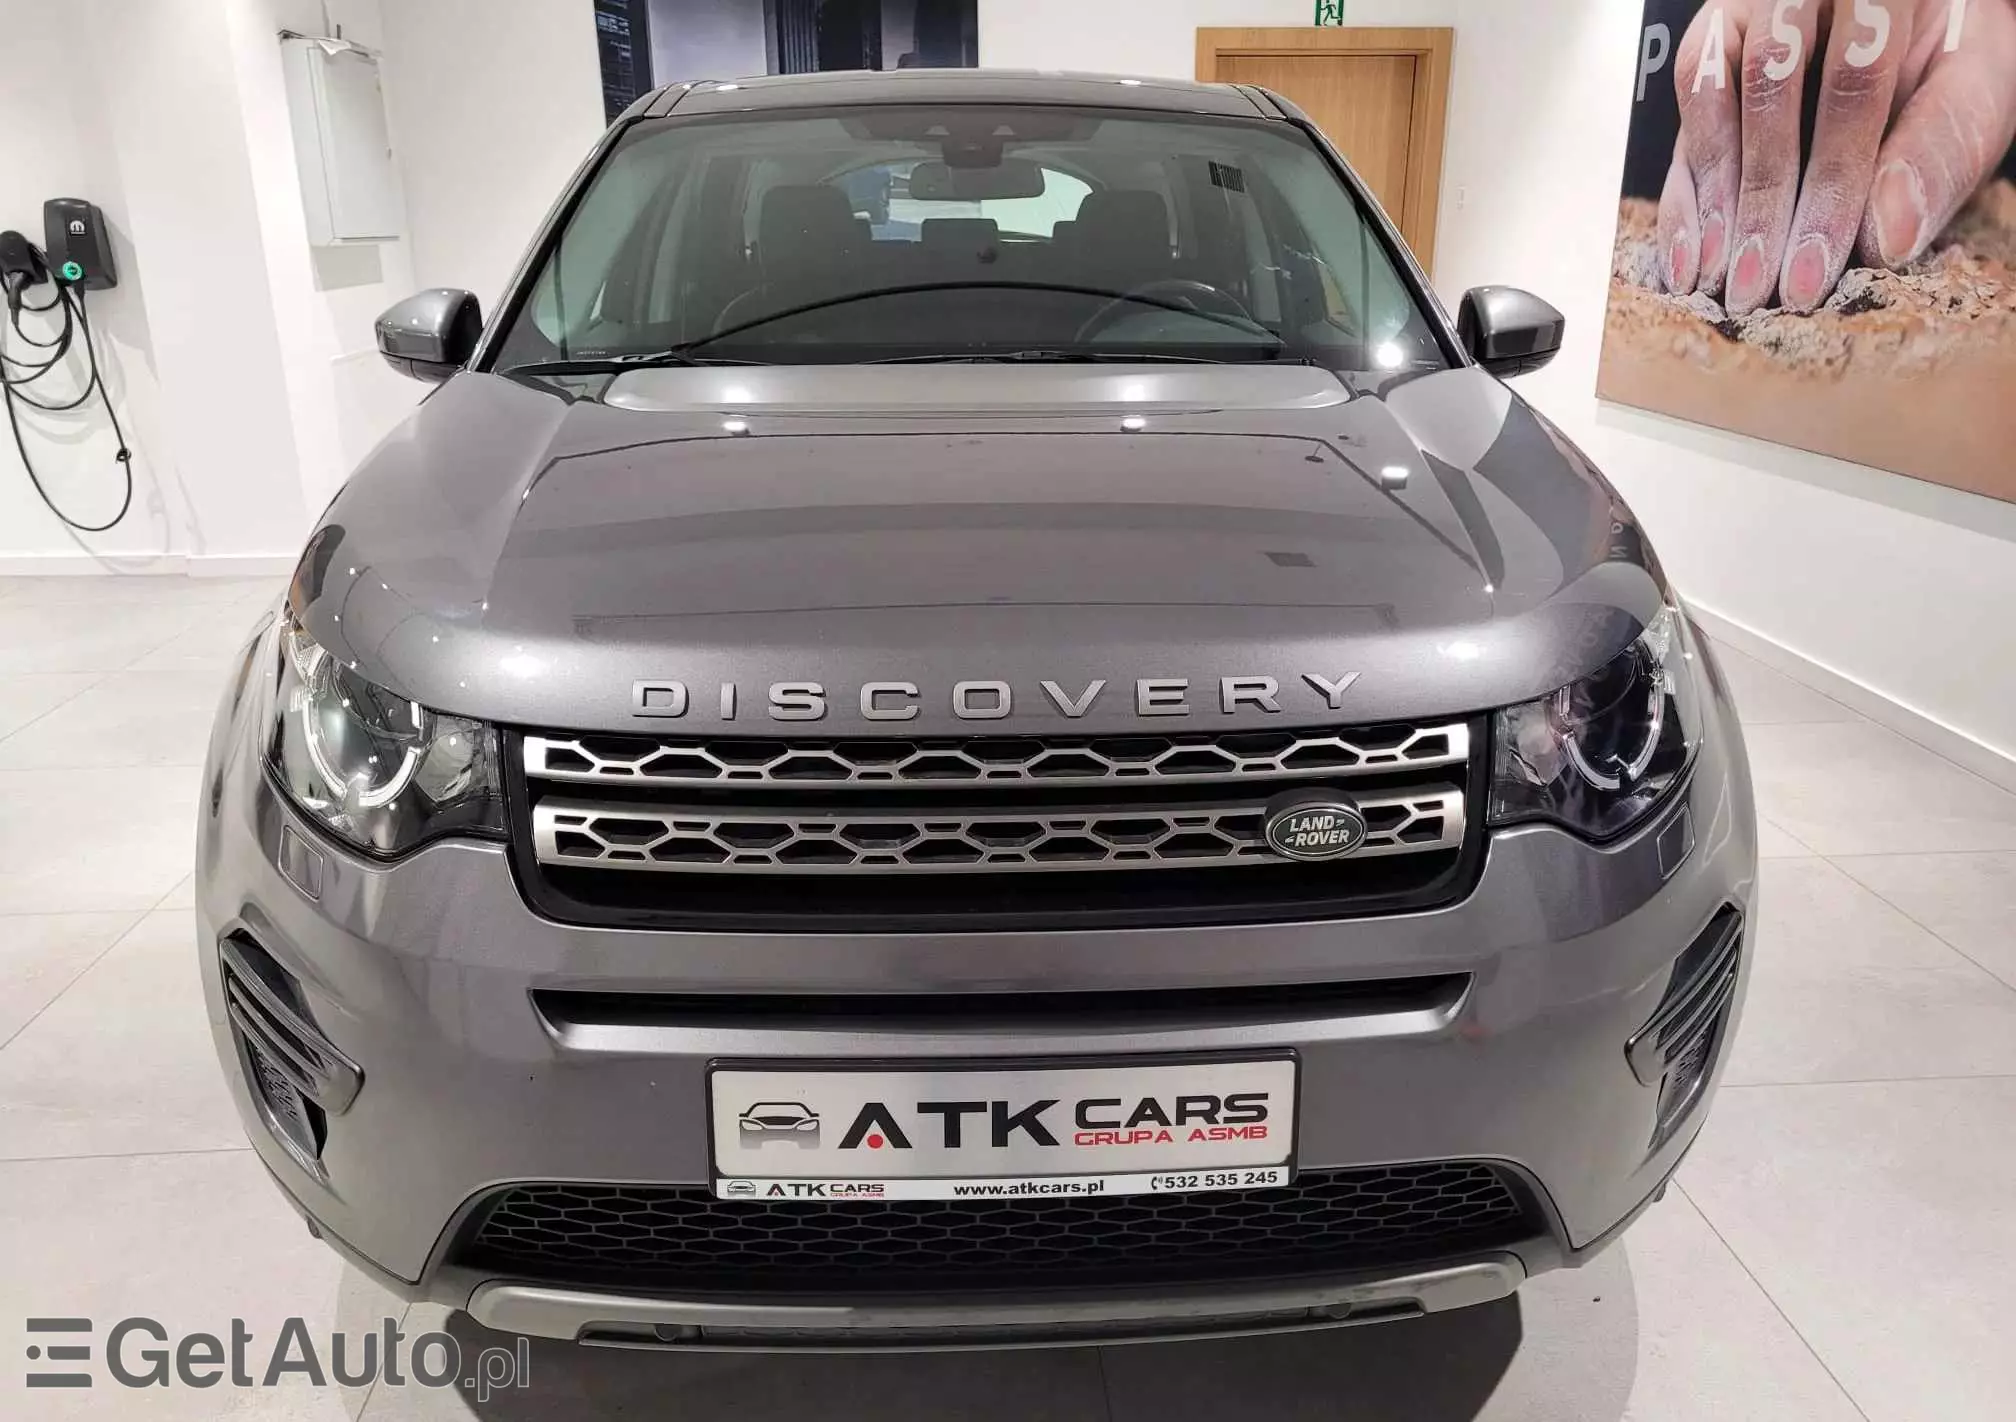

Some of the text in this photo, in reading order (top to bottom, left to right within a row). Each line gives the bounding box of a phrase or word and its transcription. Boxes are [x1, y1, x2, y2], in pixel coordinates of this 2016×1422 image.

[631, 671, 1362, 721] DISCOVERY
[1289, 815, 1335, 833] LAND
[1294, 829, 1350, 847] ROVER
[837, 1092, 1269, 1149] ATK CARS
[1074, 1125, 1268, 1146] GRUPA ASMB
[953, 1179, 1105, 1196] www.atkcars.pl
[1164, 1171, 1278, 1189] 532 535 245
[766, 1183, 885, 1197] ATK CARS
